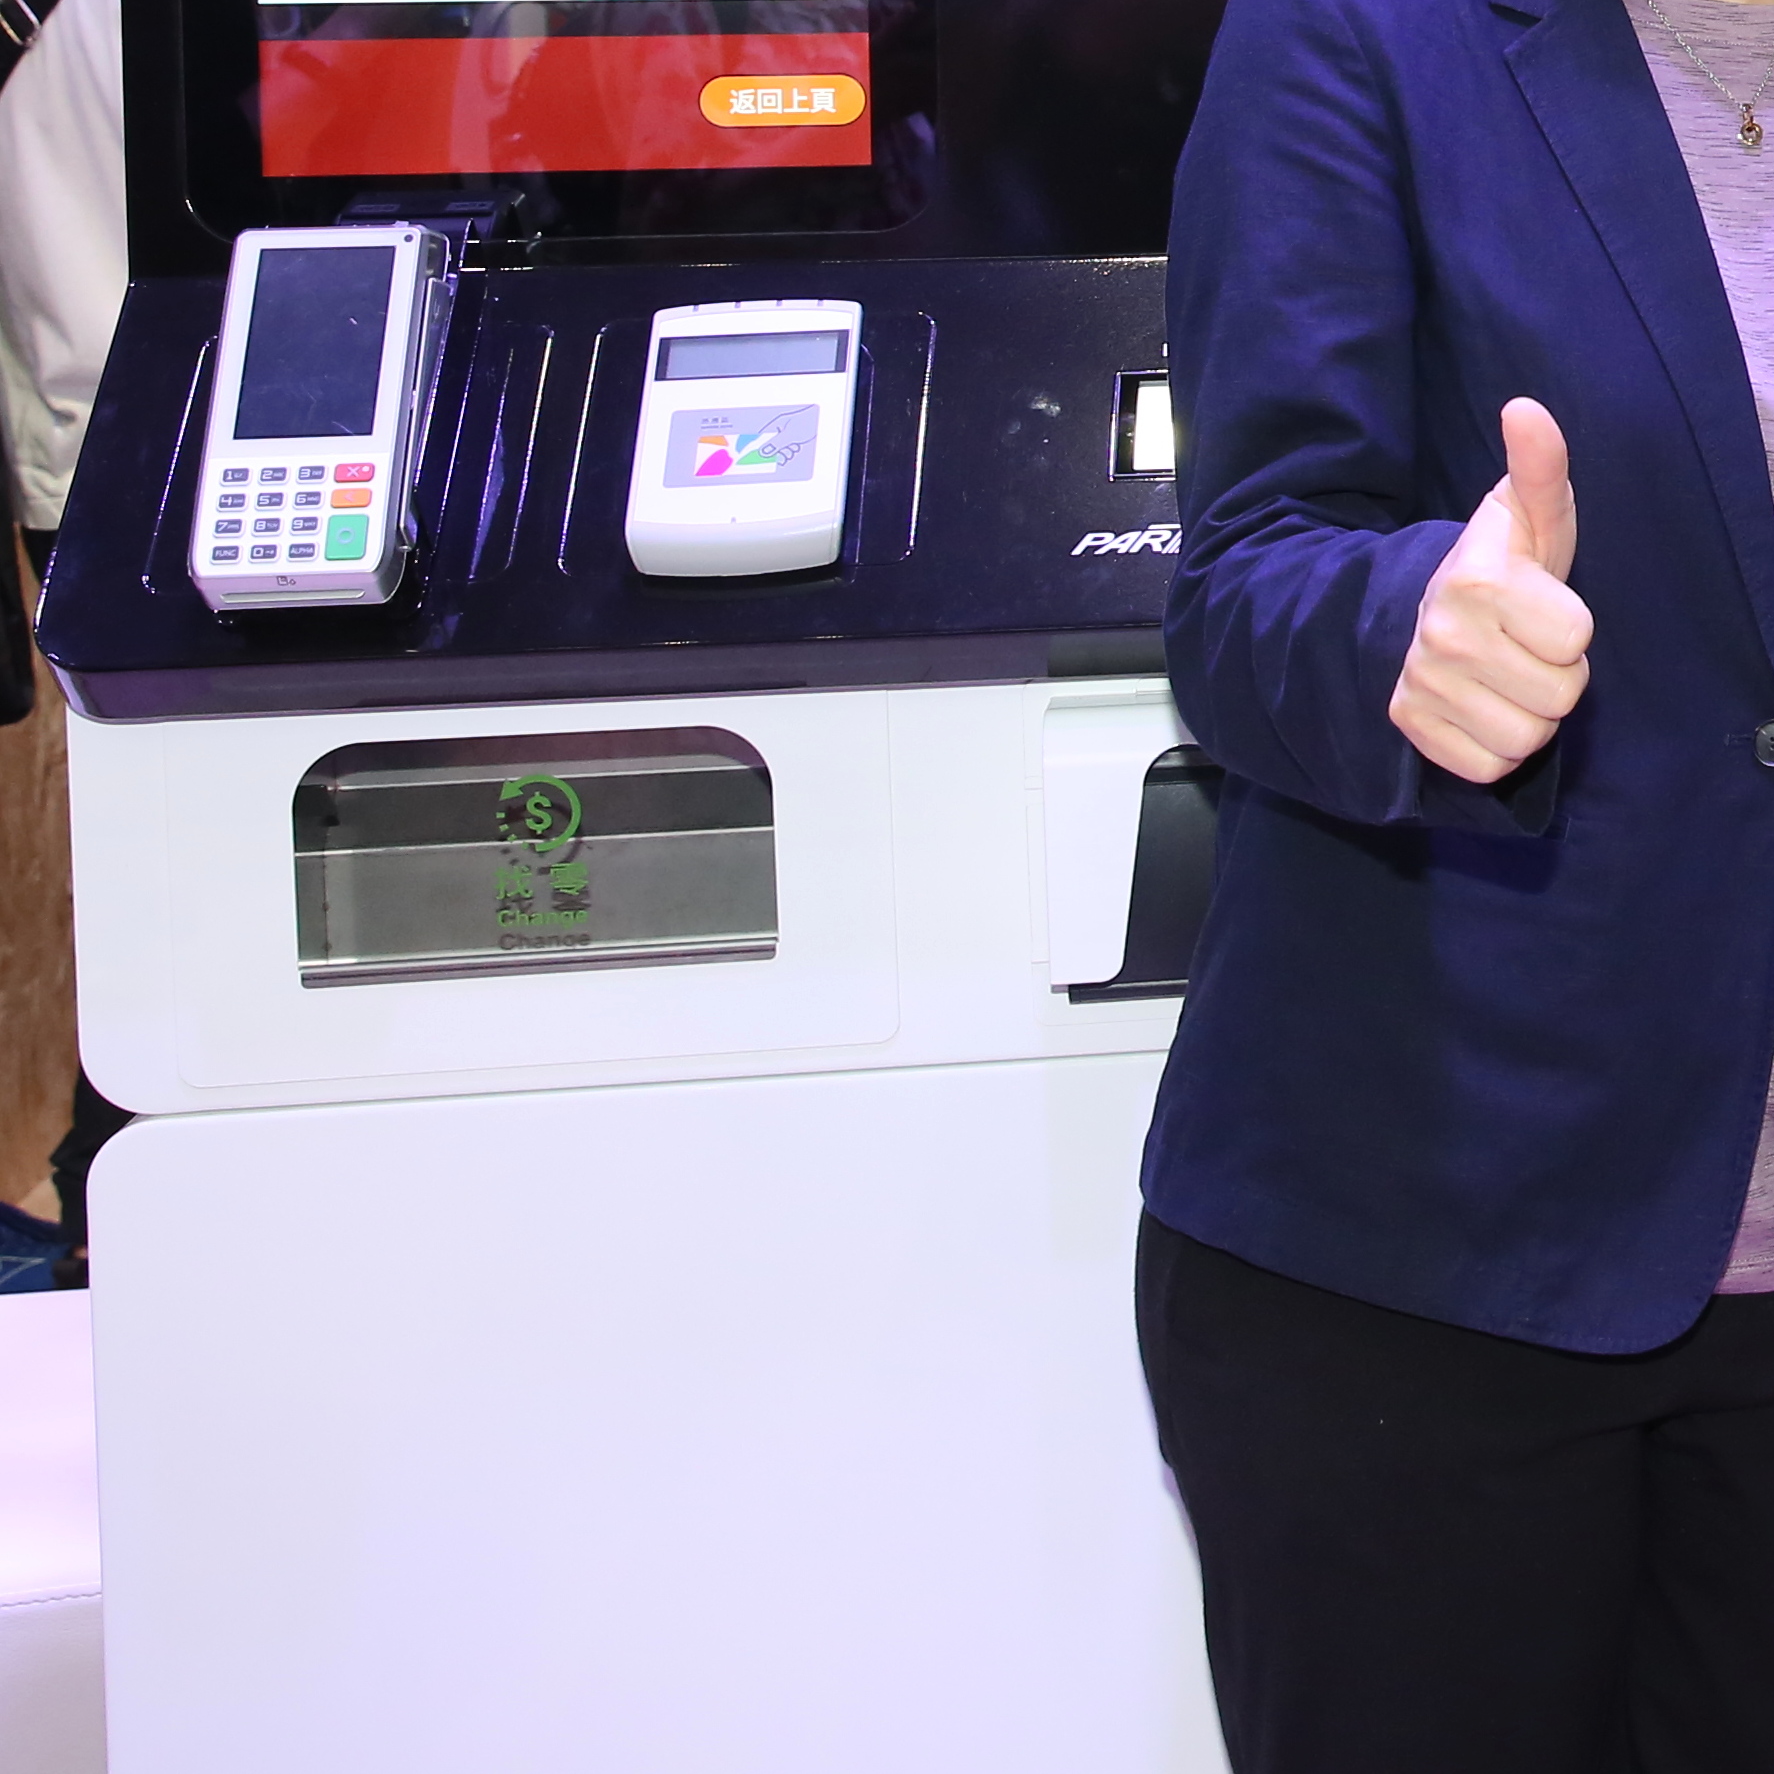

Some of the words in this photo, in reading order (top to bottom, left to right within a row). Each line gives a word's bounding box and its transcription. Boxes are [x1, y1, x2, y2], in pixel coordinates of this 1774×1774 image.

[729, 89, 837, 115] 返回上頁
[226, 471, 233, 479] 1
[262, 470, 273, 479] 2
[300, 468, 310, 477] 3
[221, 496, 232, 506] 4
[259, 495, 270, 505] 5
[296, 494, 307, 503] 6
[218, 522, 228, 531] 7
[256, 521, 266, 530] 8
[293, 520, 303, 528] 9
[215, 549, 236, 557] FUNC
[497, 909, 589, 929] Change
